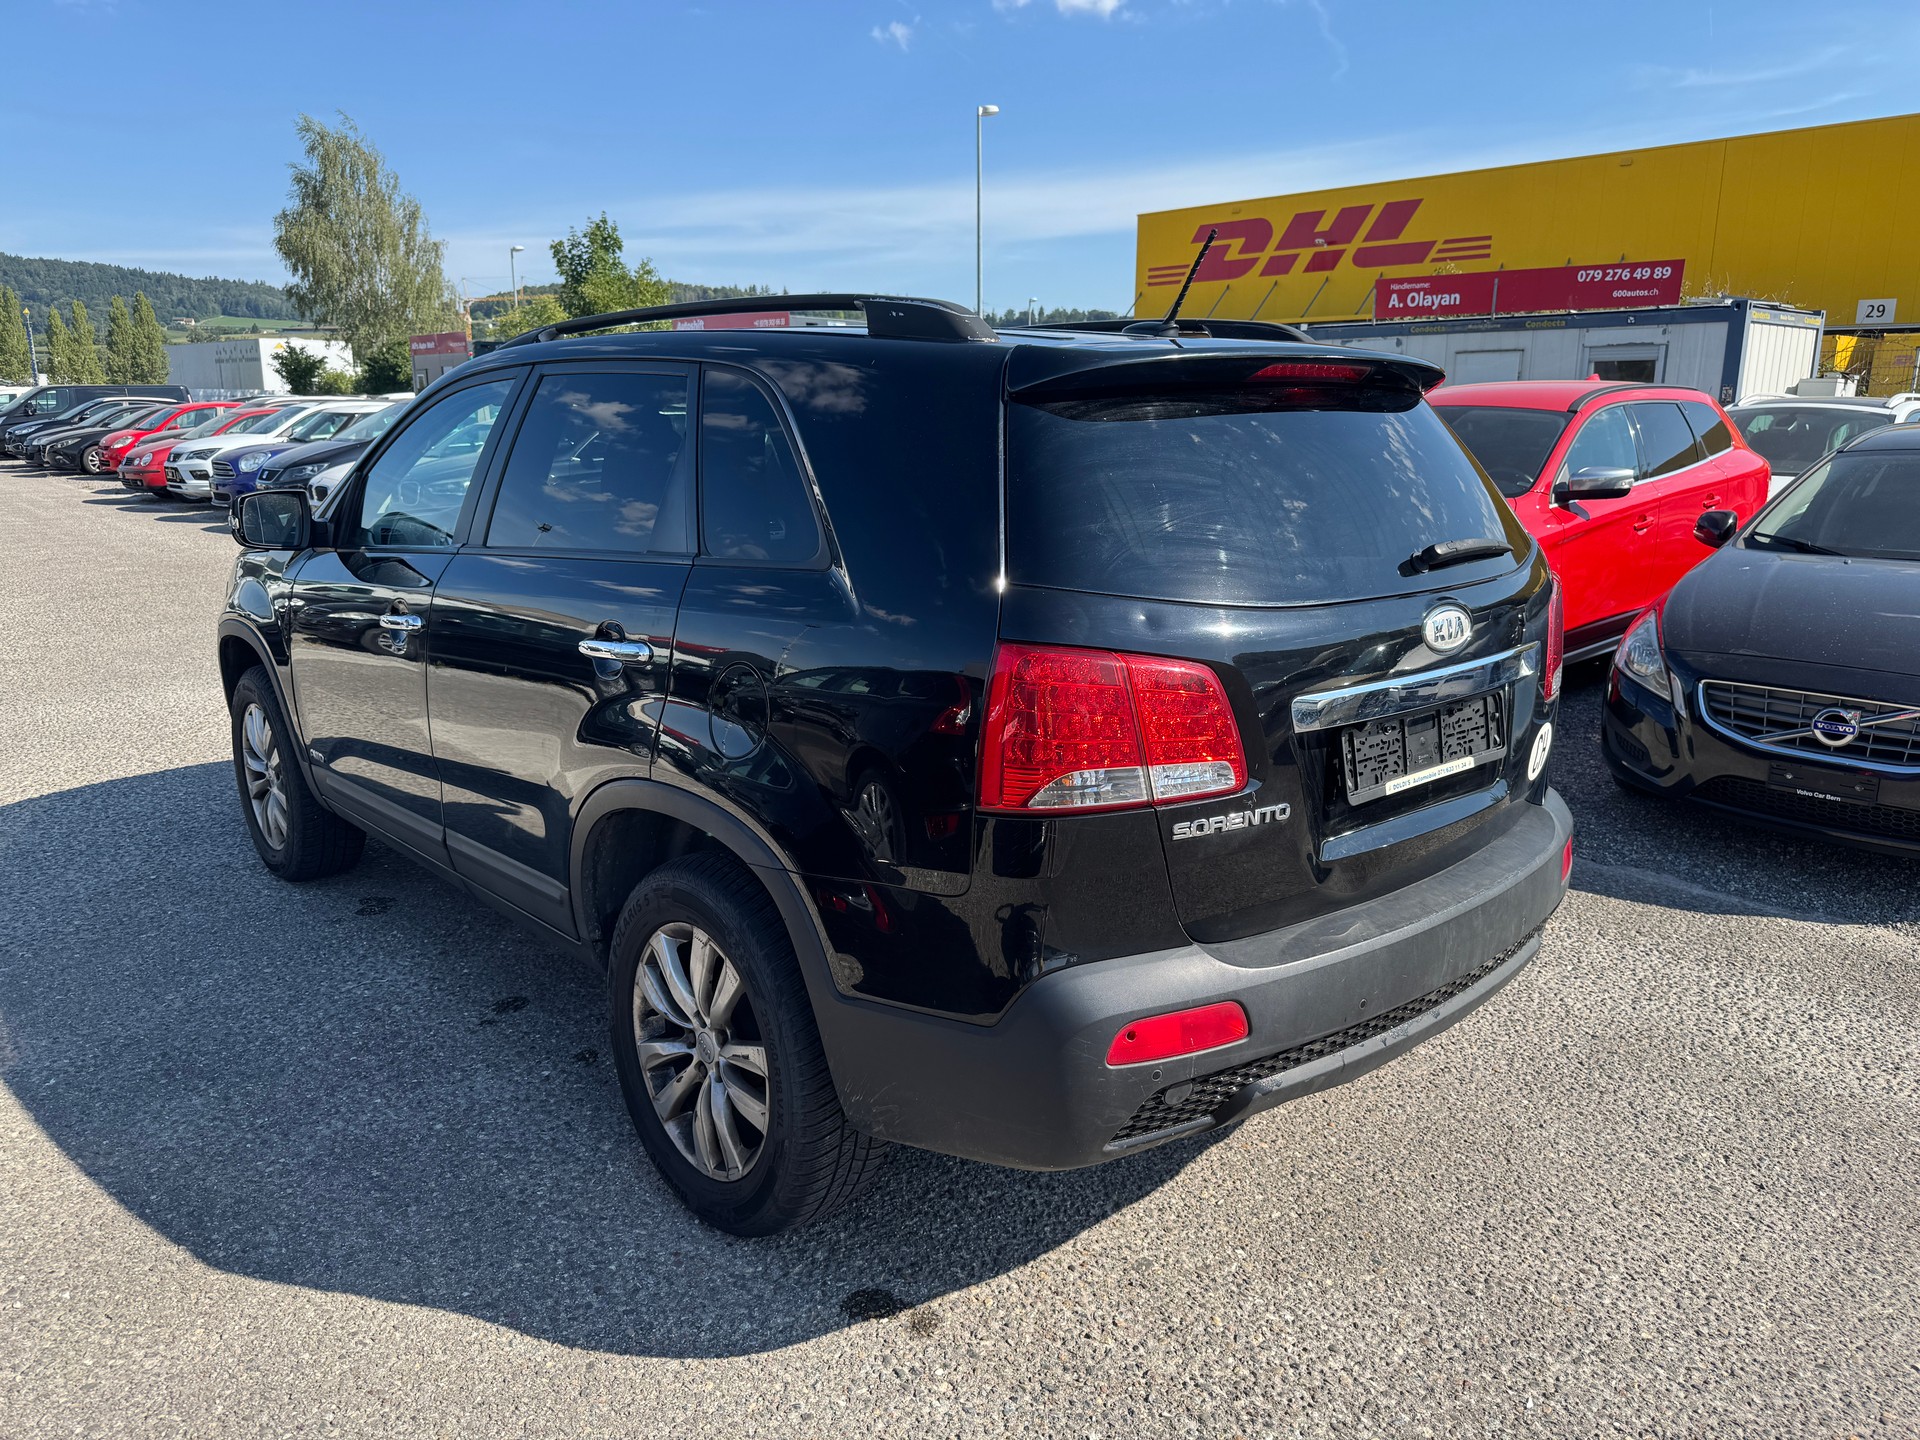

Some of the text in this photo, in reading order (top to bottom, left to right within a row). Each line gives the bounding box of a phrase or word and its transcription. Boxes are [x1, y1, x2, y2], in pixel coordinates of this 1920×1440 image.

[1191, 199, 1438, 283] DHL
[1578, 266, 1671, 282] 079 276 49 89
[1390, 282, 1431, 290] Händlername:
[1612, 287, 1659, 298] 600autos.ch
[1389, 291, 1460, 310] A. Olayan
[1865, 304, 1886, 318] 29
[1525, 319, 1565, 328] Condecta
[1432, 616, 1464, 643] KIA
[1816, 722, 1854, 733] VOLVO
[1532, 729, 1550, 773] CH
[1796, 789, 1813, 797] Volvo
[1172, 803, 1291, 841] SORENTO
